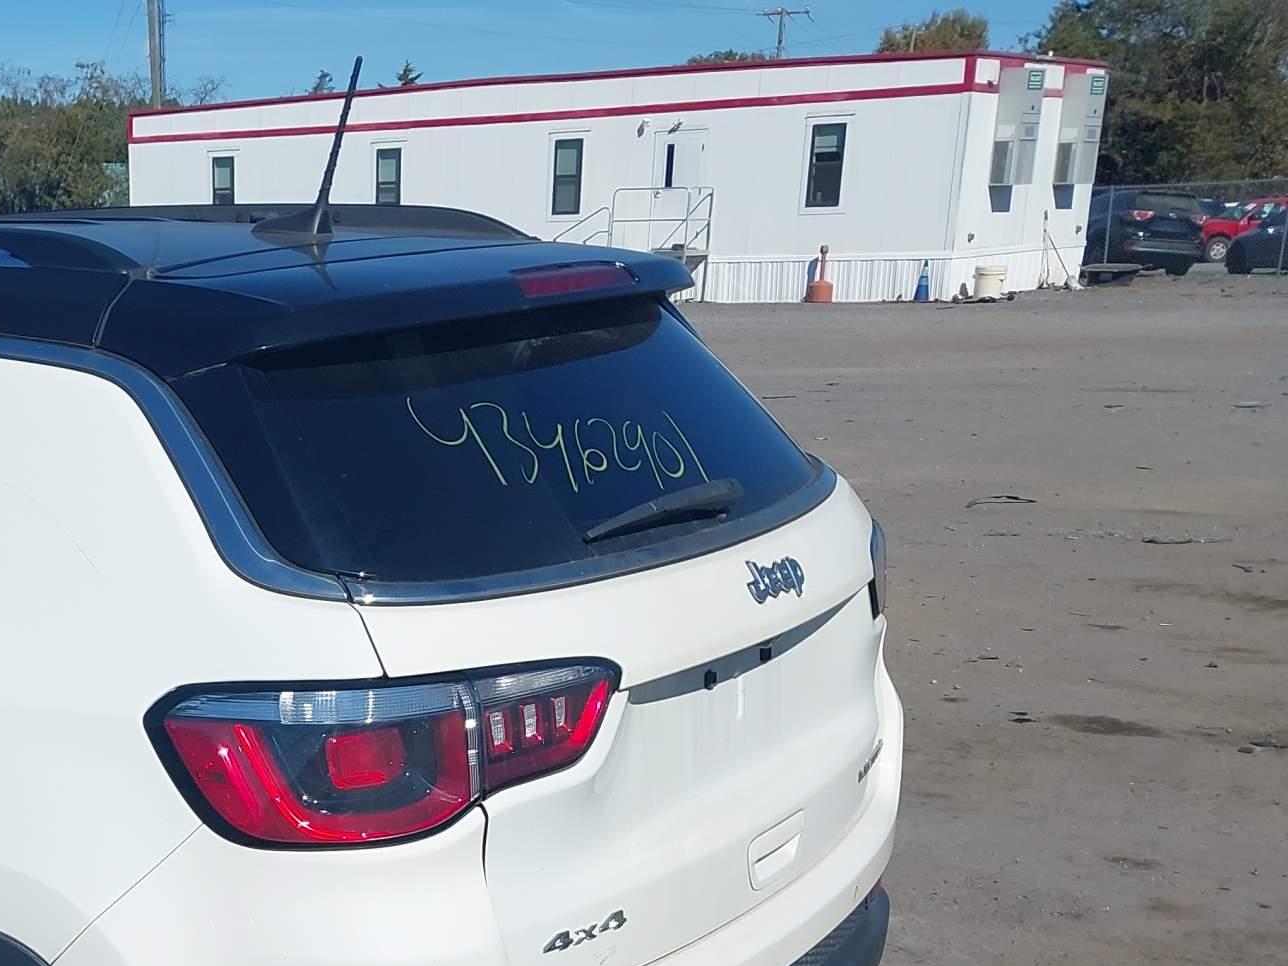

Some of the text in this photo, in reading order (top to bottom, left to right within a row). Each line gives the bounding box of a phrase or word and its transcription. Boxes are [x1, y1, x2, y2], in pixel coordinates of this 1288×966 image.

[406, 396, 710, 493] 43462901
[745, 556, 805, 605] Jeep
[542, 908, 628, 954] 4x4
